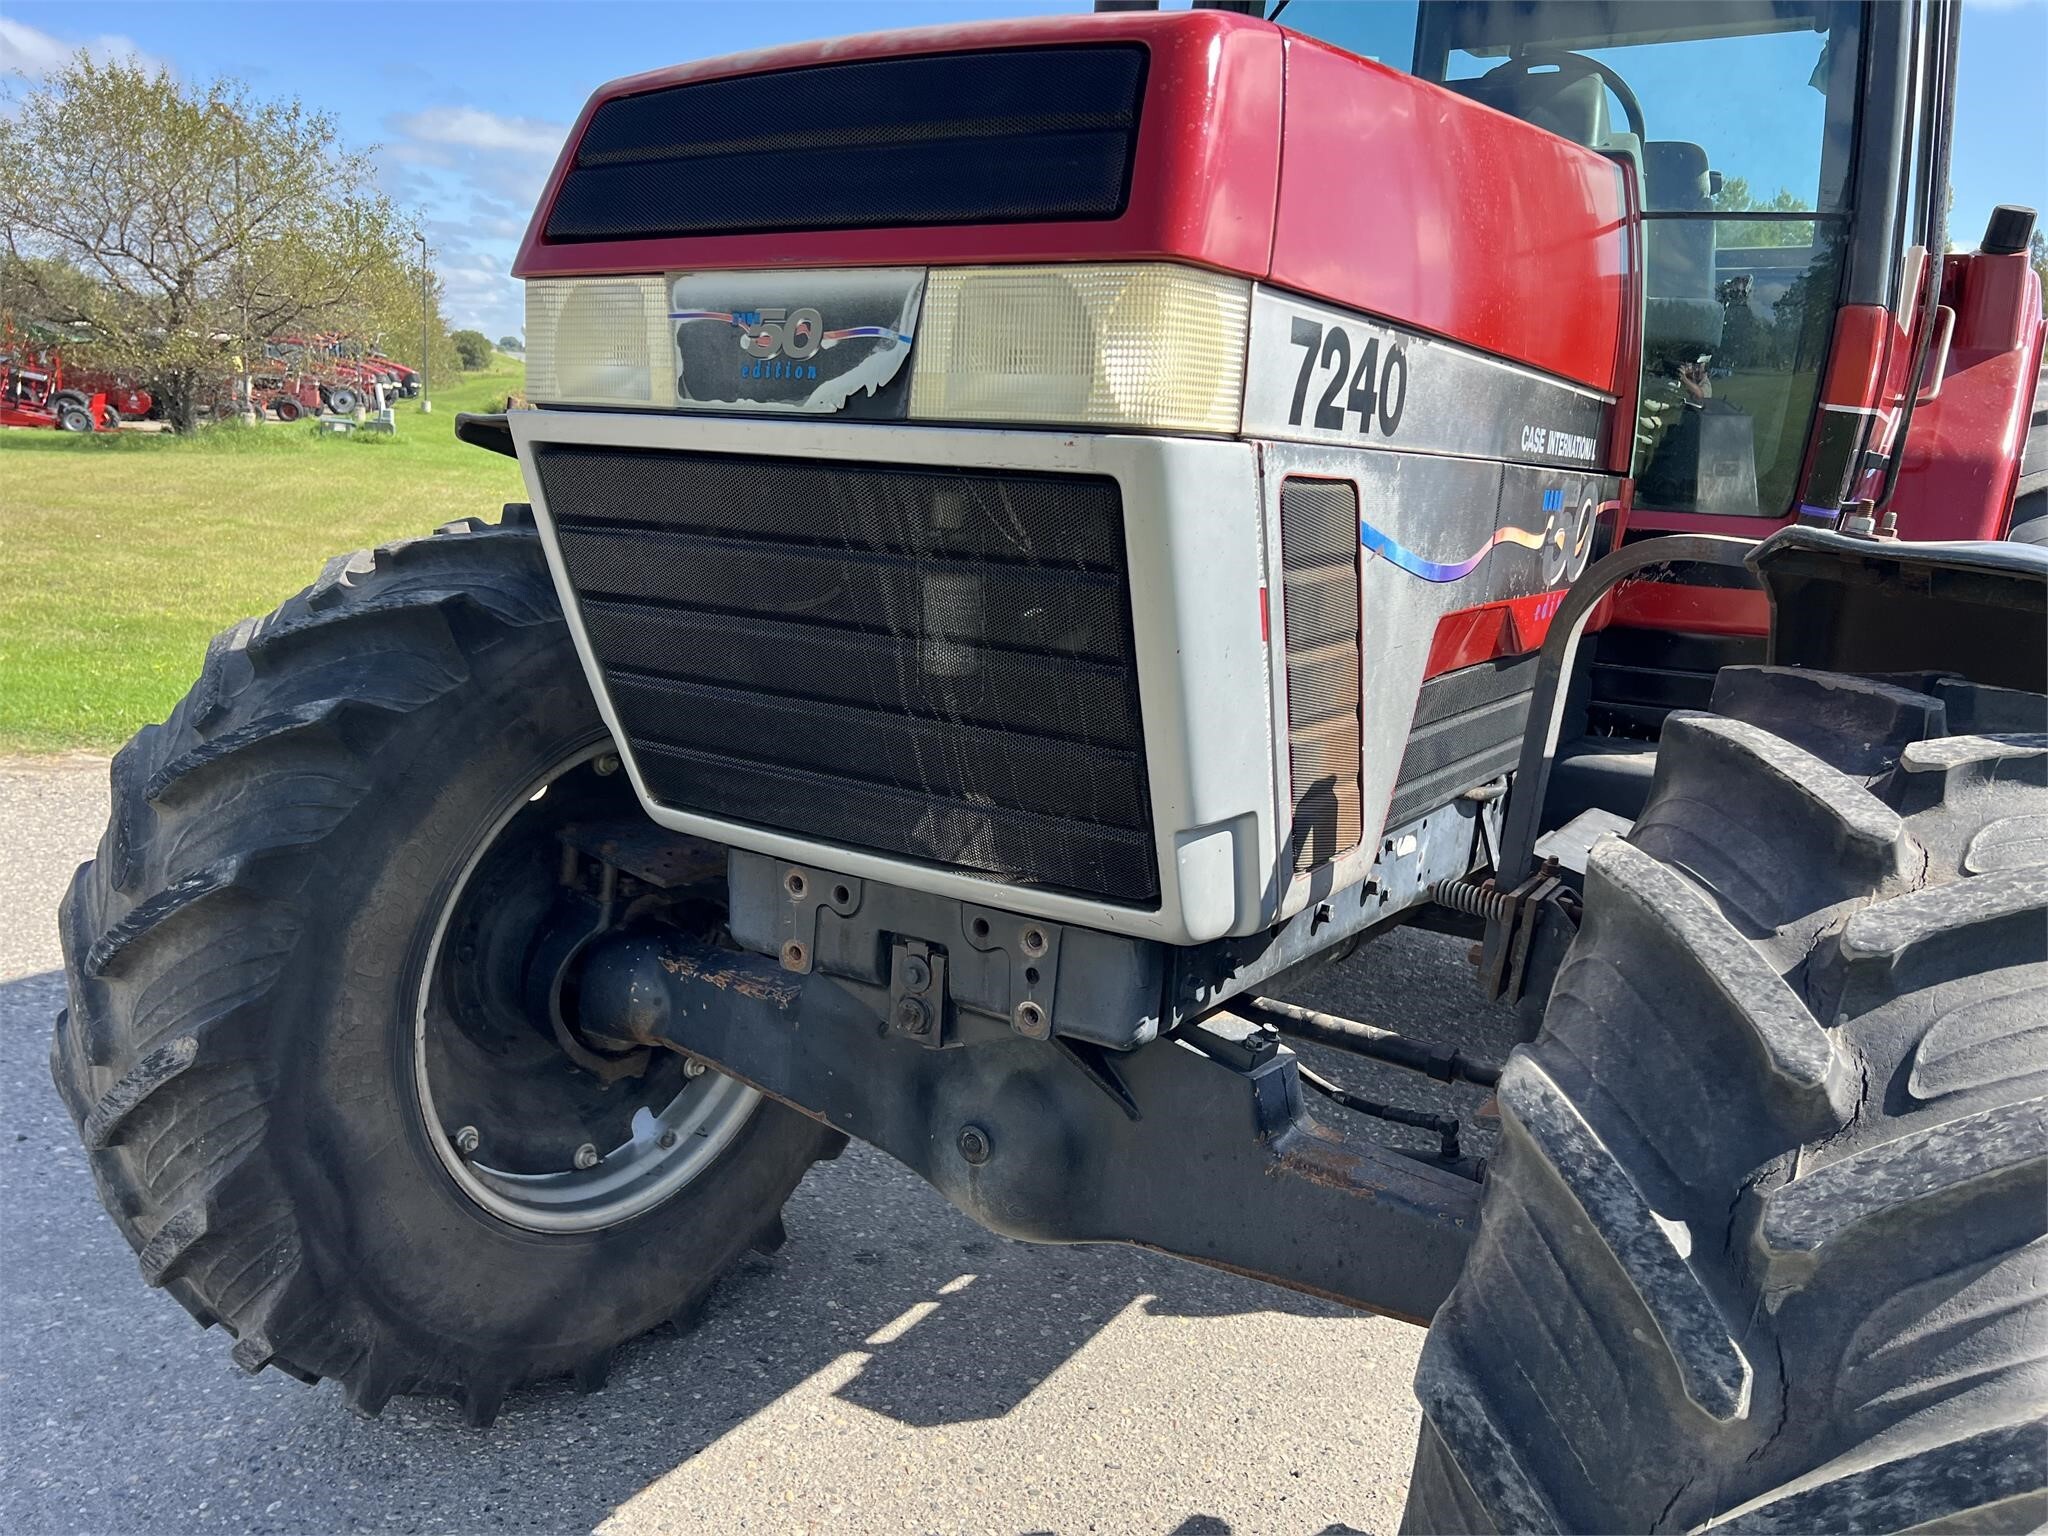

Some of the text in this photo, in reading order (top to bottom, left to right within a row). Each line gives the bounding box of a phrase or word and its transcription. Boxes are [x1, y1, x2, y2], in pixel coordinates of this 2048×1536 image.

[747, 308, 823, 361] 50
[742, 361, 816, 379] edition
[1288, 316, 1407, 437] 7240
[1521, 425, 1547, 453] CASE
